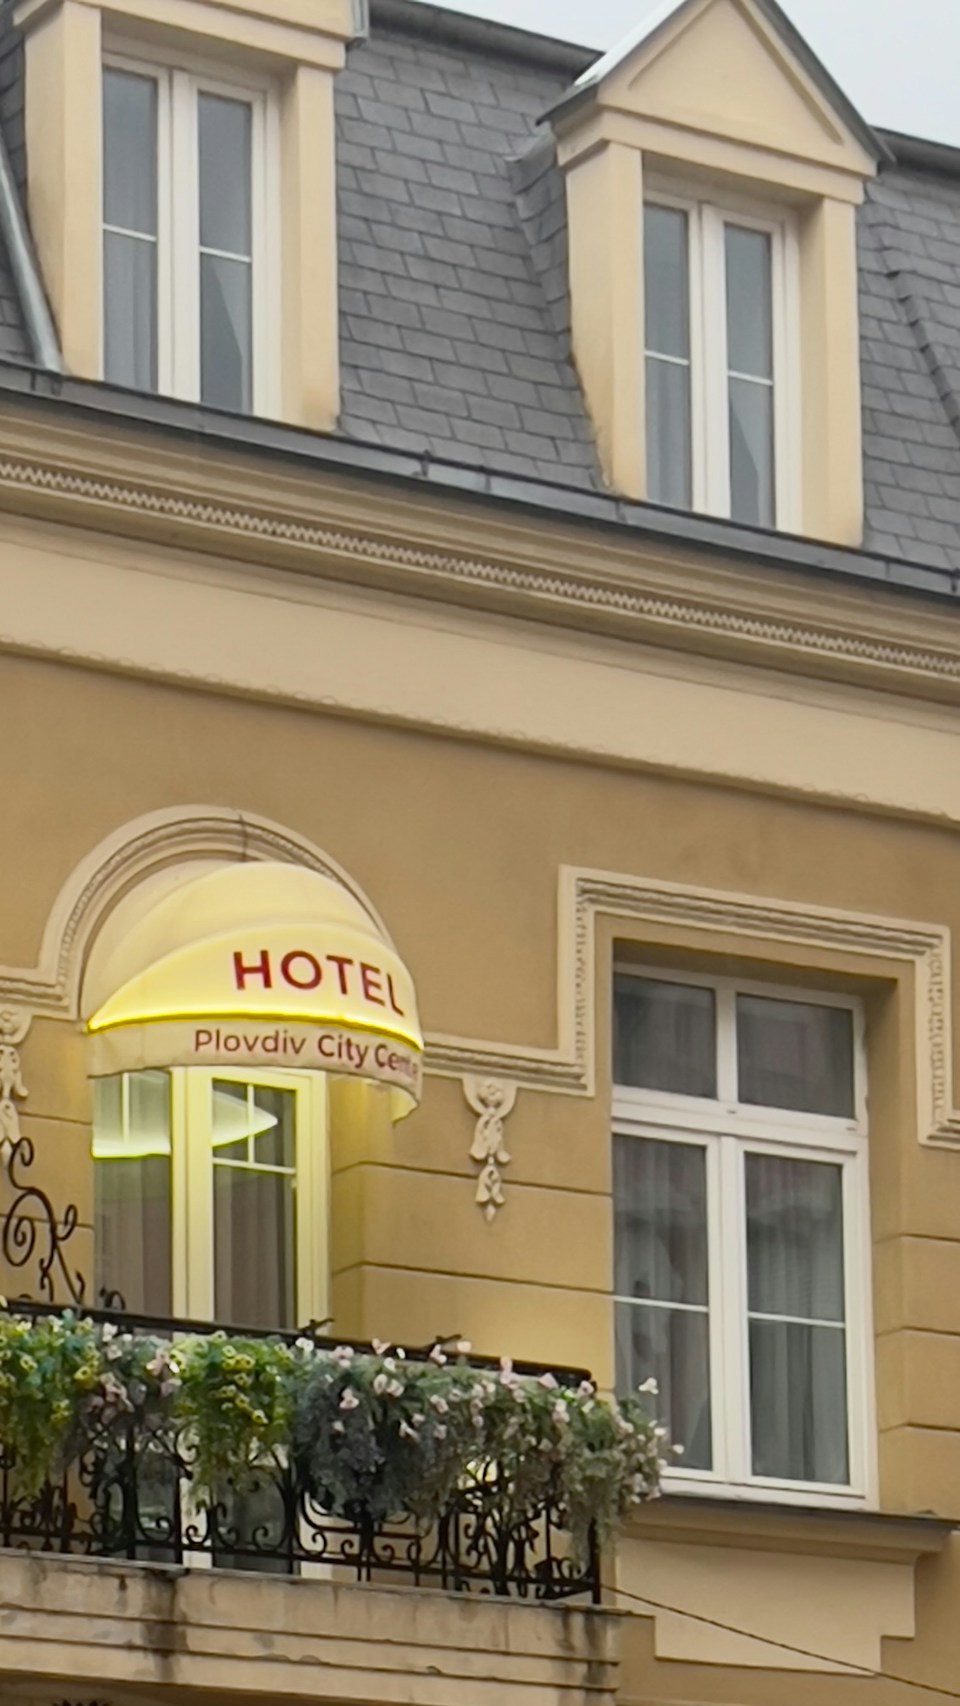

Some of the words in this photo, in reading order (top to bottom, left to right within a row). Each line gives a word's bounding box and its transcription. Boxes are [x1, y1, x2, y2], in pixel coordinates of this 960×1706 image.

[233, 950, 405, 1017] HOTEL
[194, 1028, 307, 1055] Plovdiv
[316, 1034, 370, 1068] City
